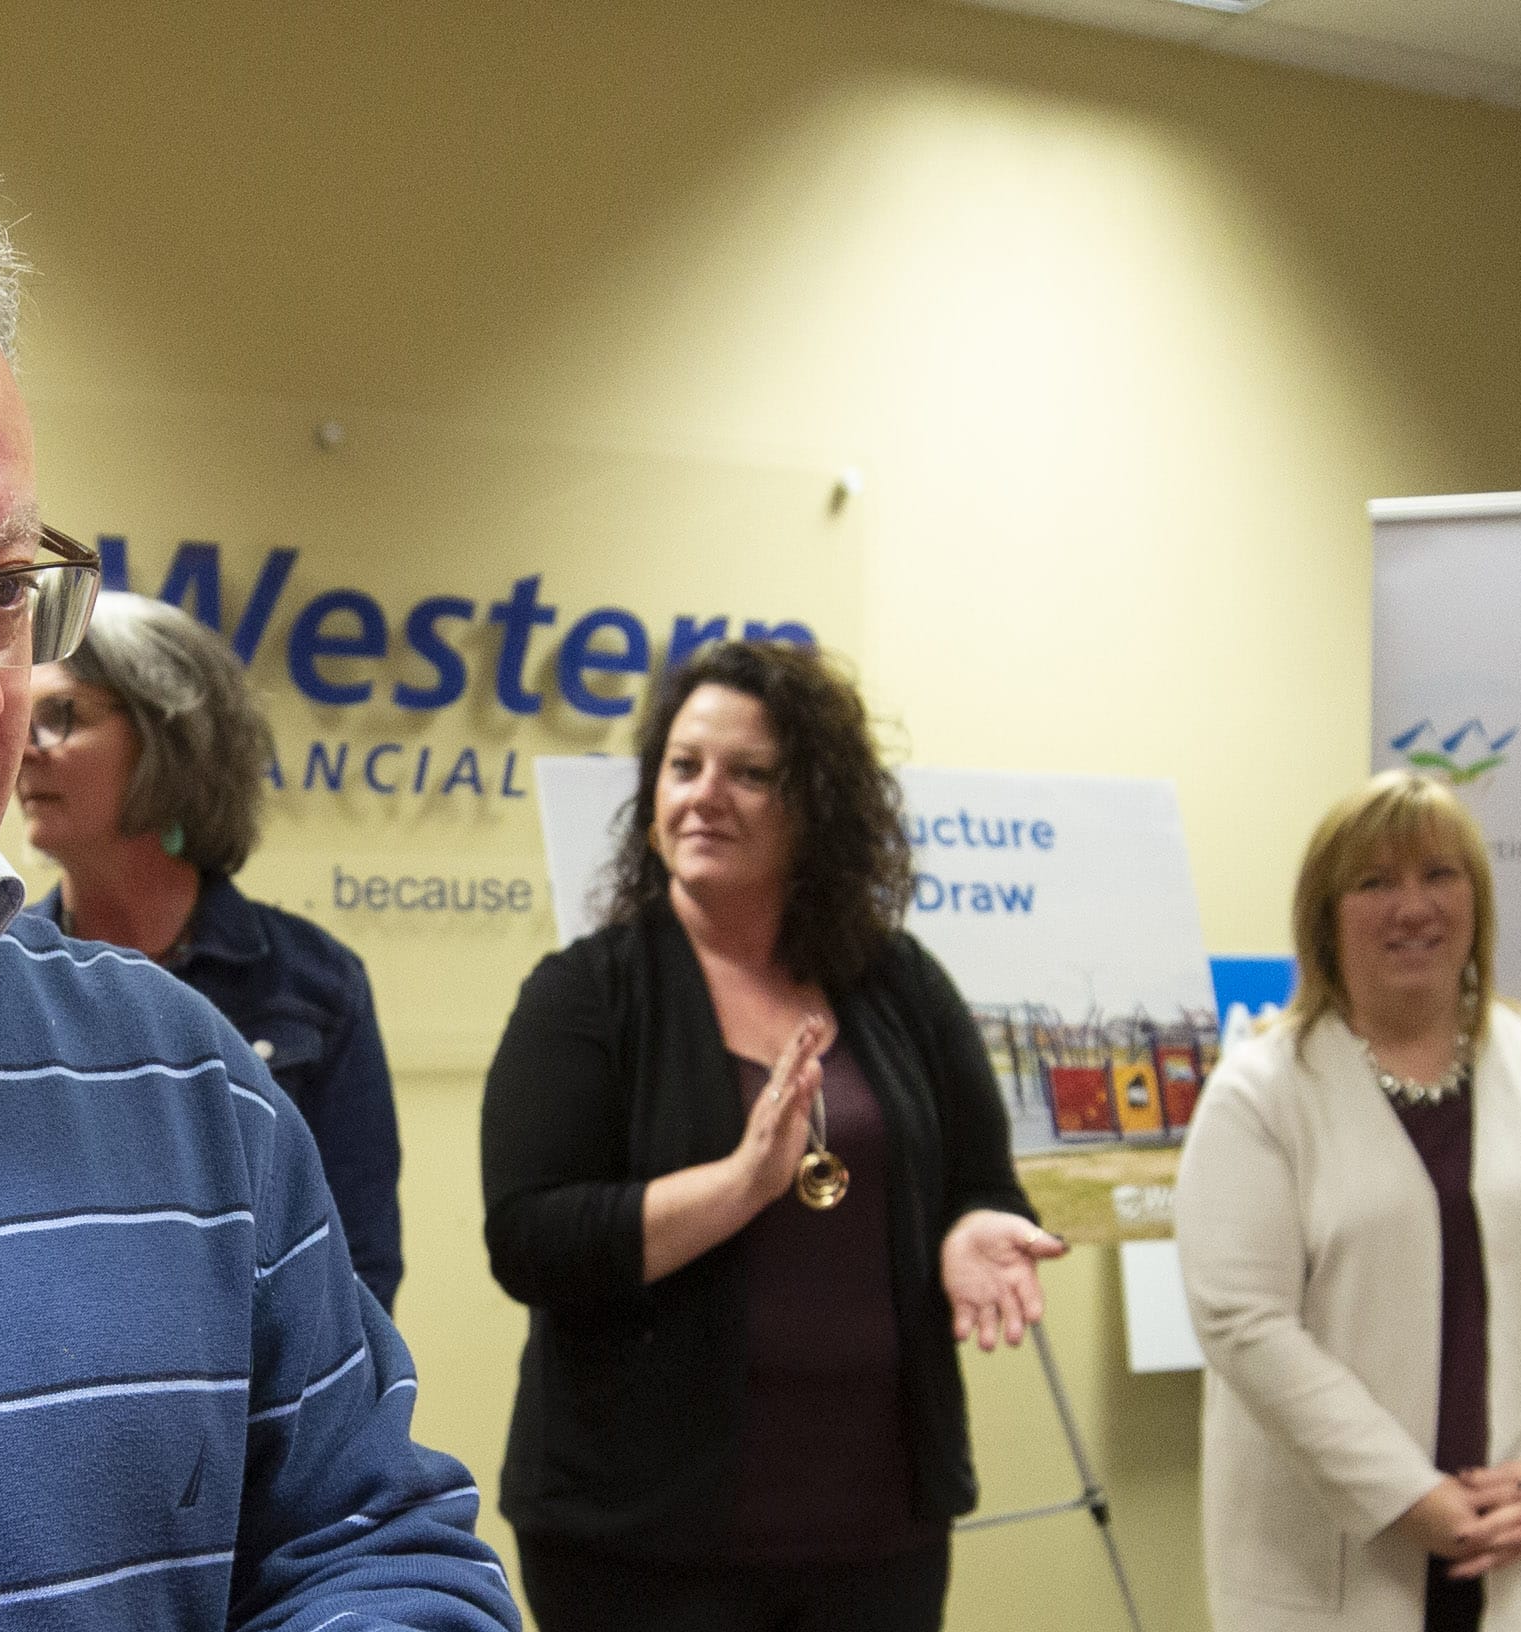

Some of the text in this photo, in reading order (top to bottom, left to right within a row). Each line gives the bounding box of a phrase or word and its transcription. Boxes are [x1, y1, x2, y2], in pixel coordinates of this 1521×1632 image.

[97, 534, 818, 720] Wester
[333, 865, 534, 913] because
[912, 871, 1035, 914] Draw
